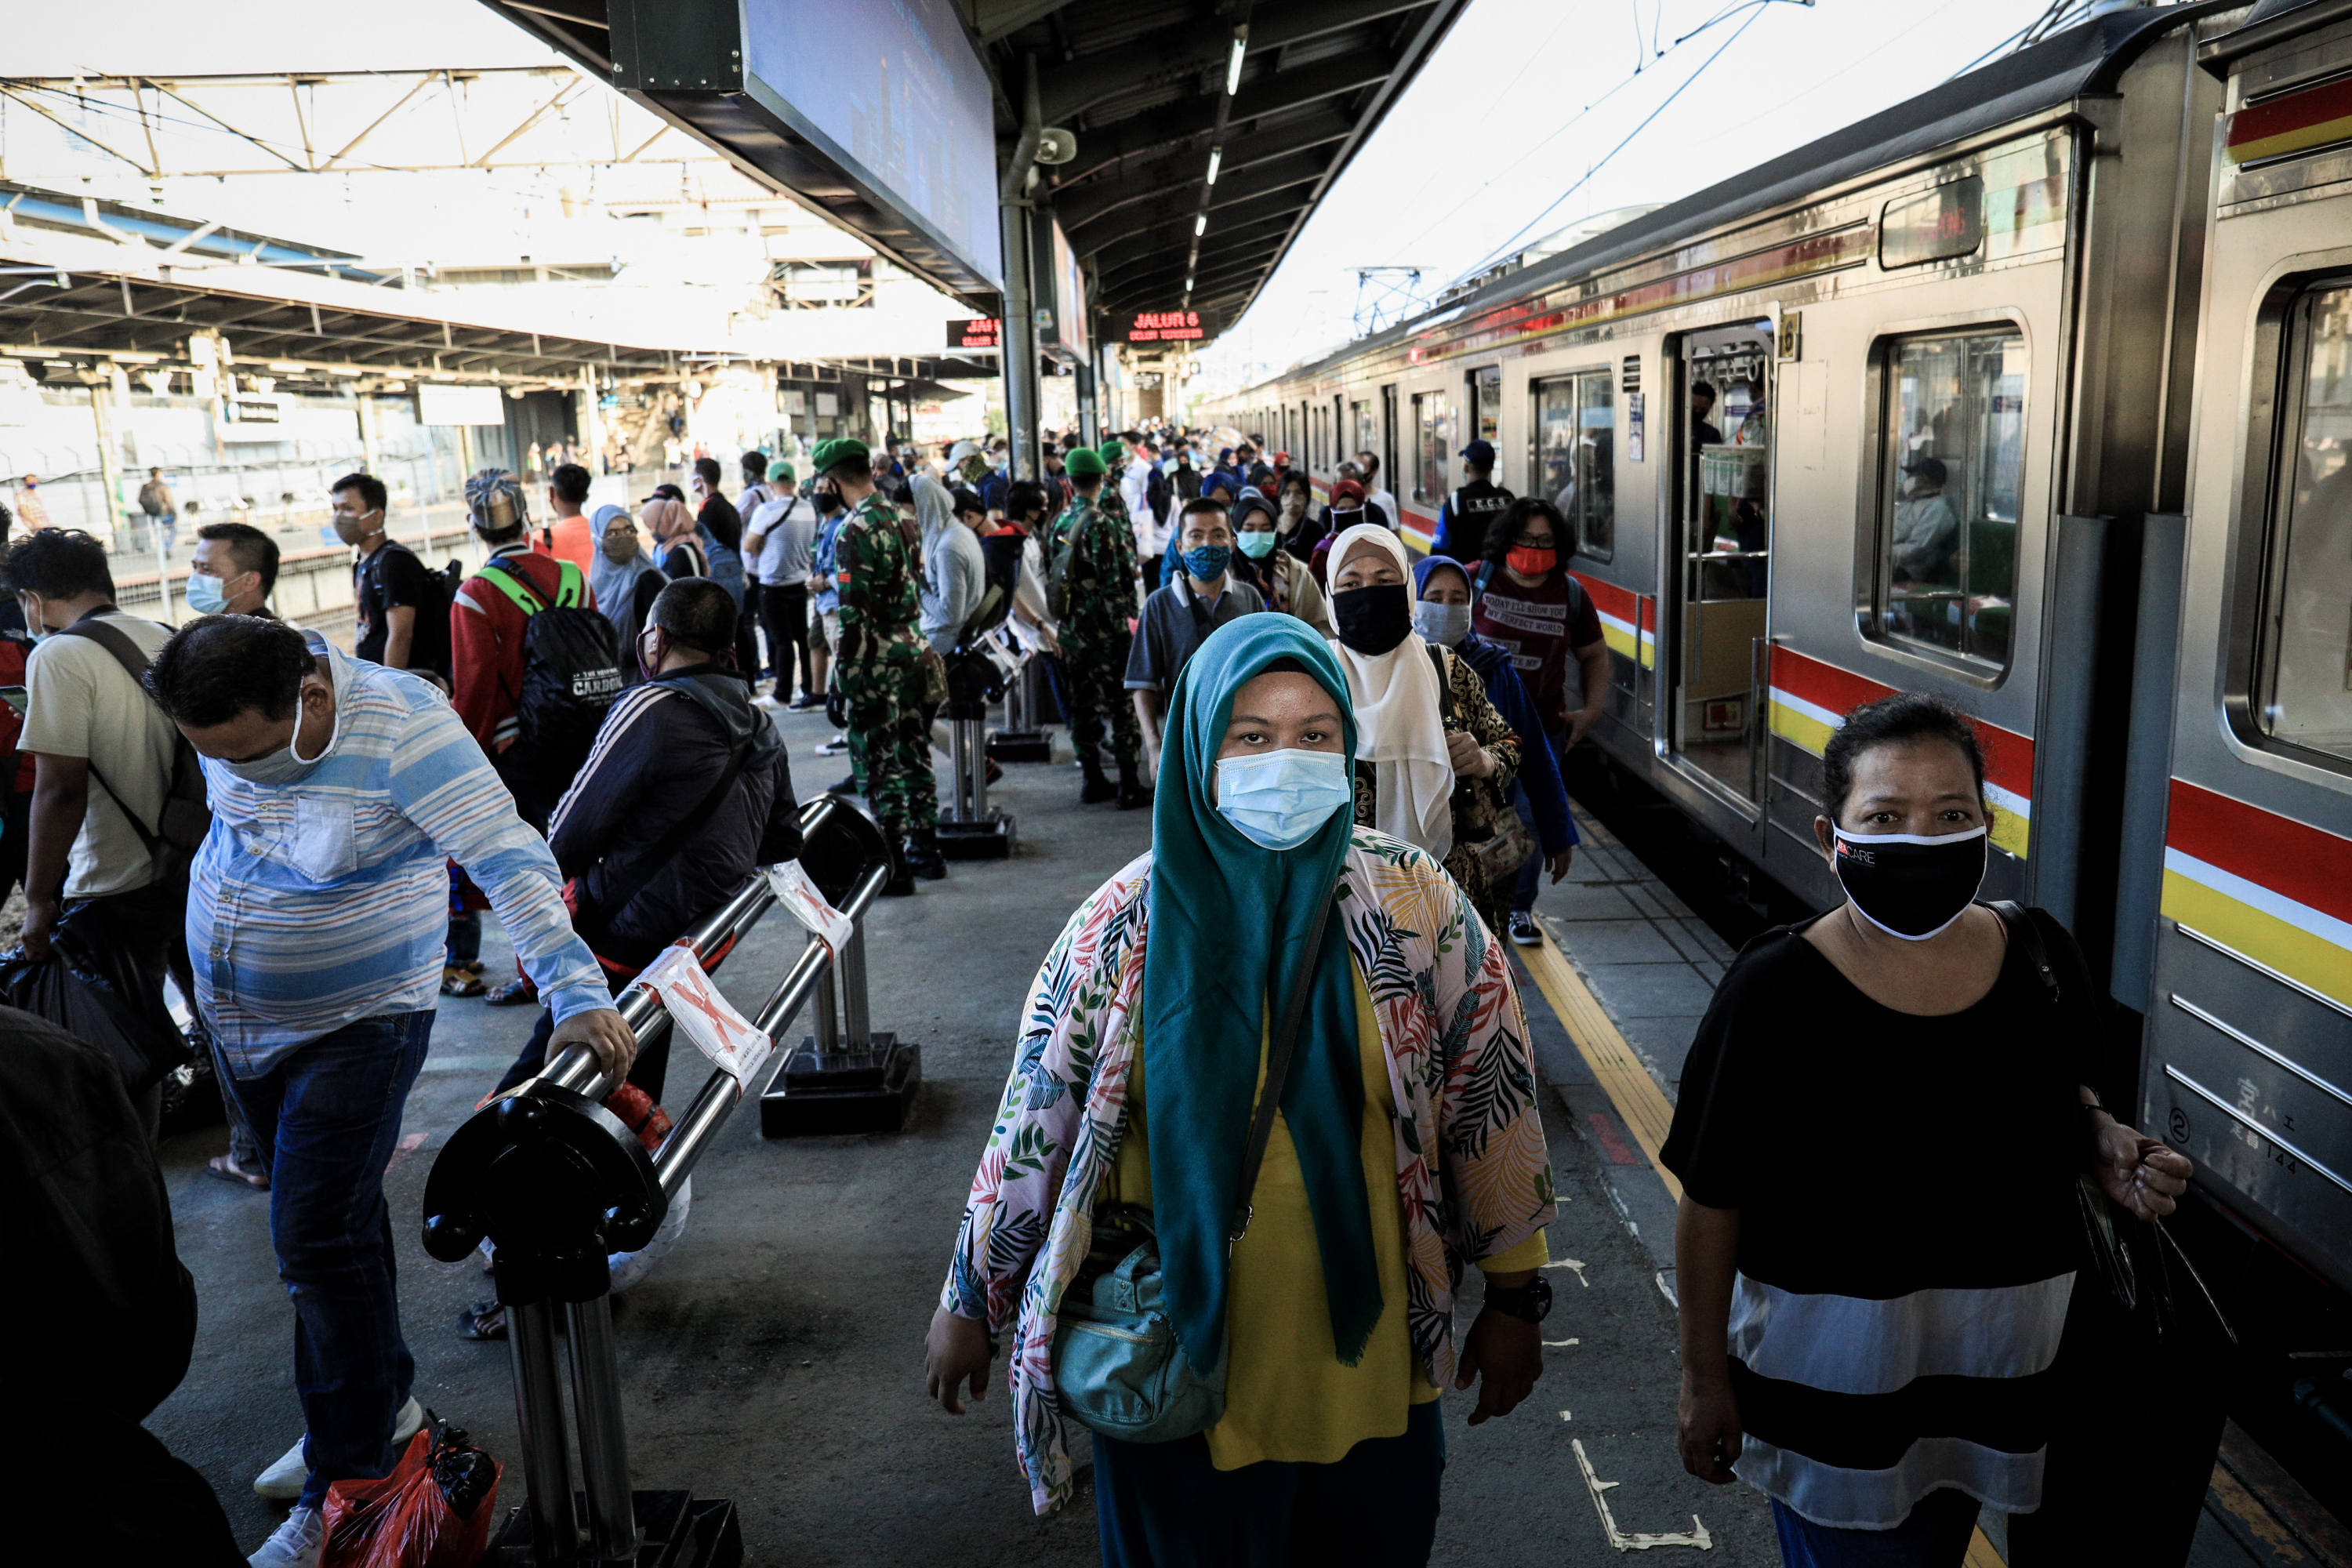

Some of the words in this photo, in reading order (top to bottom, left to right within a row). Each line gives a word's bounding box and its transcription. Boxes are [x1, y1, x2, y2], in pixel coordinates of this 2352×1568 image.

[1134, 312, 1185, 328] JALUR
[1485, 596, 1510, 609] TODAY
[1527, 604, 1548, 614] SHOW
[1549, 607, 1563, 616] YOU
[1488, 608, 1499, 617] MY
[1501, 613, 1534, 628] PERFECT
[1536, 622, 1563, 633] WORLD
[1847, 845, 1875, 865] CARE
